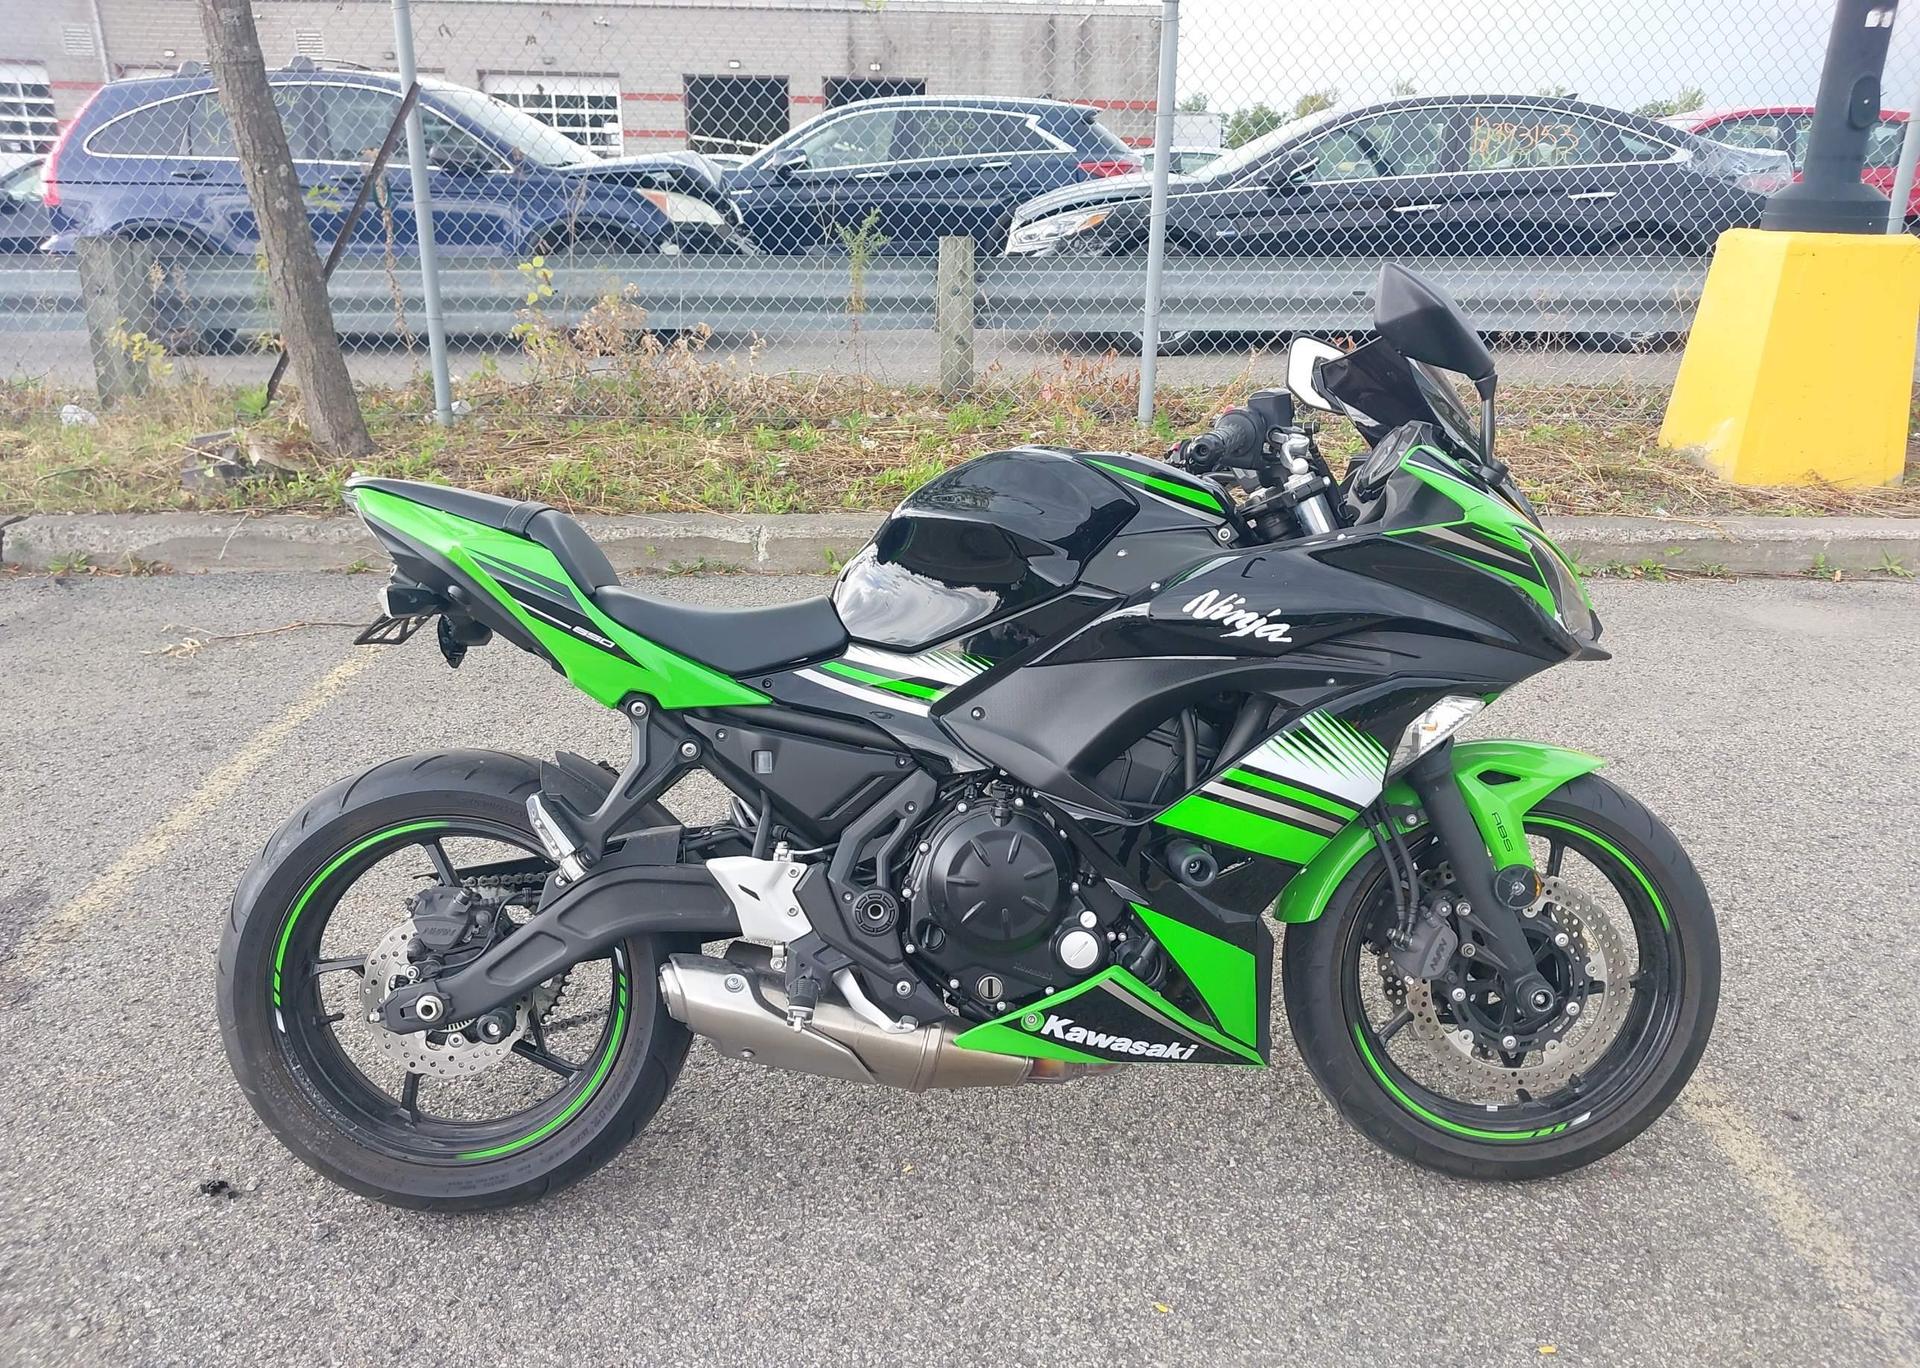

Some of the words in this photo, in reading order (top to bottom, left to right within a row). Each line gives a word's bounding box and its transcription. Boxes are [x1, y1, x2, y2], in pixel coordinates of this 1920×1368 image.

[572, 625, 615, 648] 650
[1182, 589, 1292, 642] Ninja
[1492, 811, 1513, 852] ABS
[1041, 1014, 1199, 1060] Kawasaki
